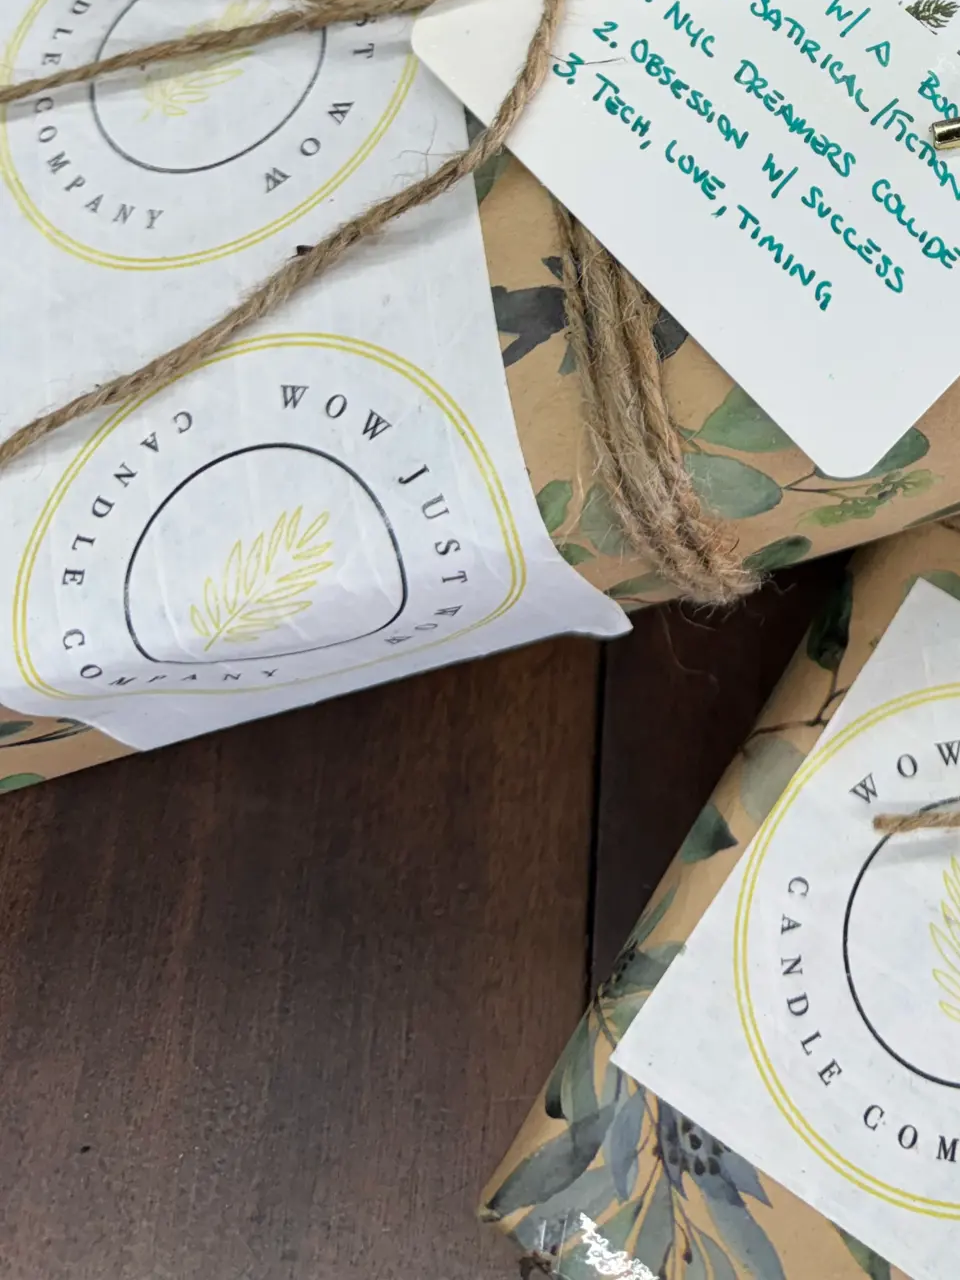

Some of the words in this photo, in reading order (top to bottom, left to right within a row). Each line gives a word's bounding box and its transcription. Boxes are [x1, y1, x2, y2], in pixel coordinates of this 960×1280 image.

[664, 0, 715, 58] NYC
[734, 59, 857, 178] DREAMERS
[864, 40, 892, 68] A
[34, 96, 165, 231] COMPANY
[263, 100, 355, 194] WOW
[553, 52, 576, 85] 3.
[590, 74, 652, 151] TECH,
[665, 138, 727, 219] LOVE,
[736, 204, 833, 312] TIMING
[592, 20, 619, 50] 2.
[630, 40, 749, 150] OBSESSION
[761, 153, 798, 198] W/
[801, 187, 905, 295] SUCCESS
[280, 384, 393, 443] WOW
[61, 410, 195, 588] CANDLE
[398, 463, 468, 587] JUST
[62, 628, 280, 687] COMPANY
[384, 605, 464, 645] WOW
[780, 874, 844, 1087] CANDLE
